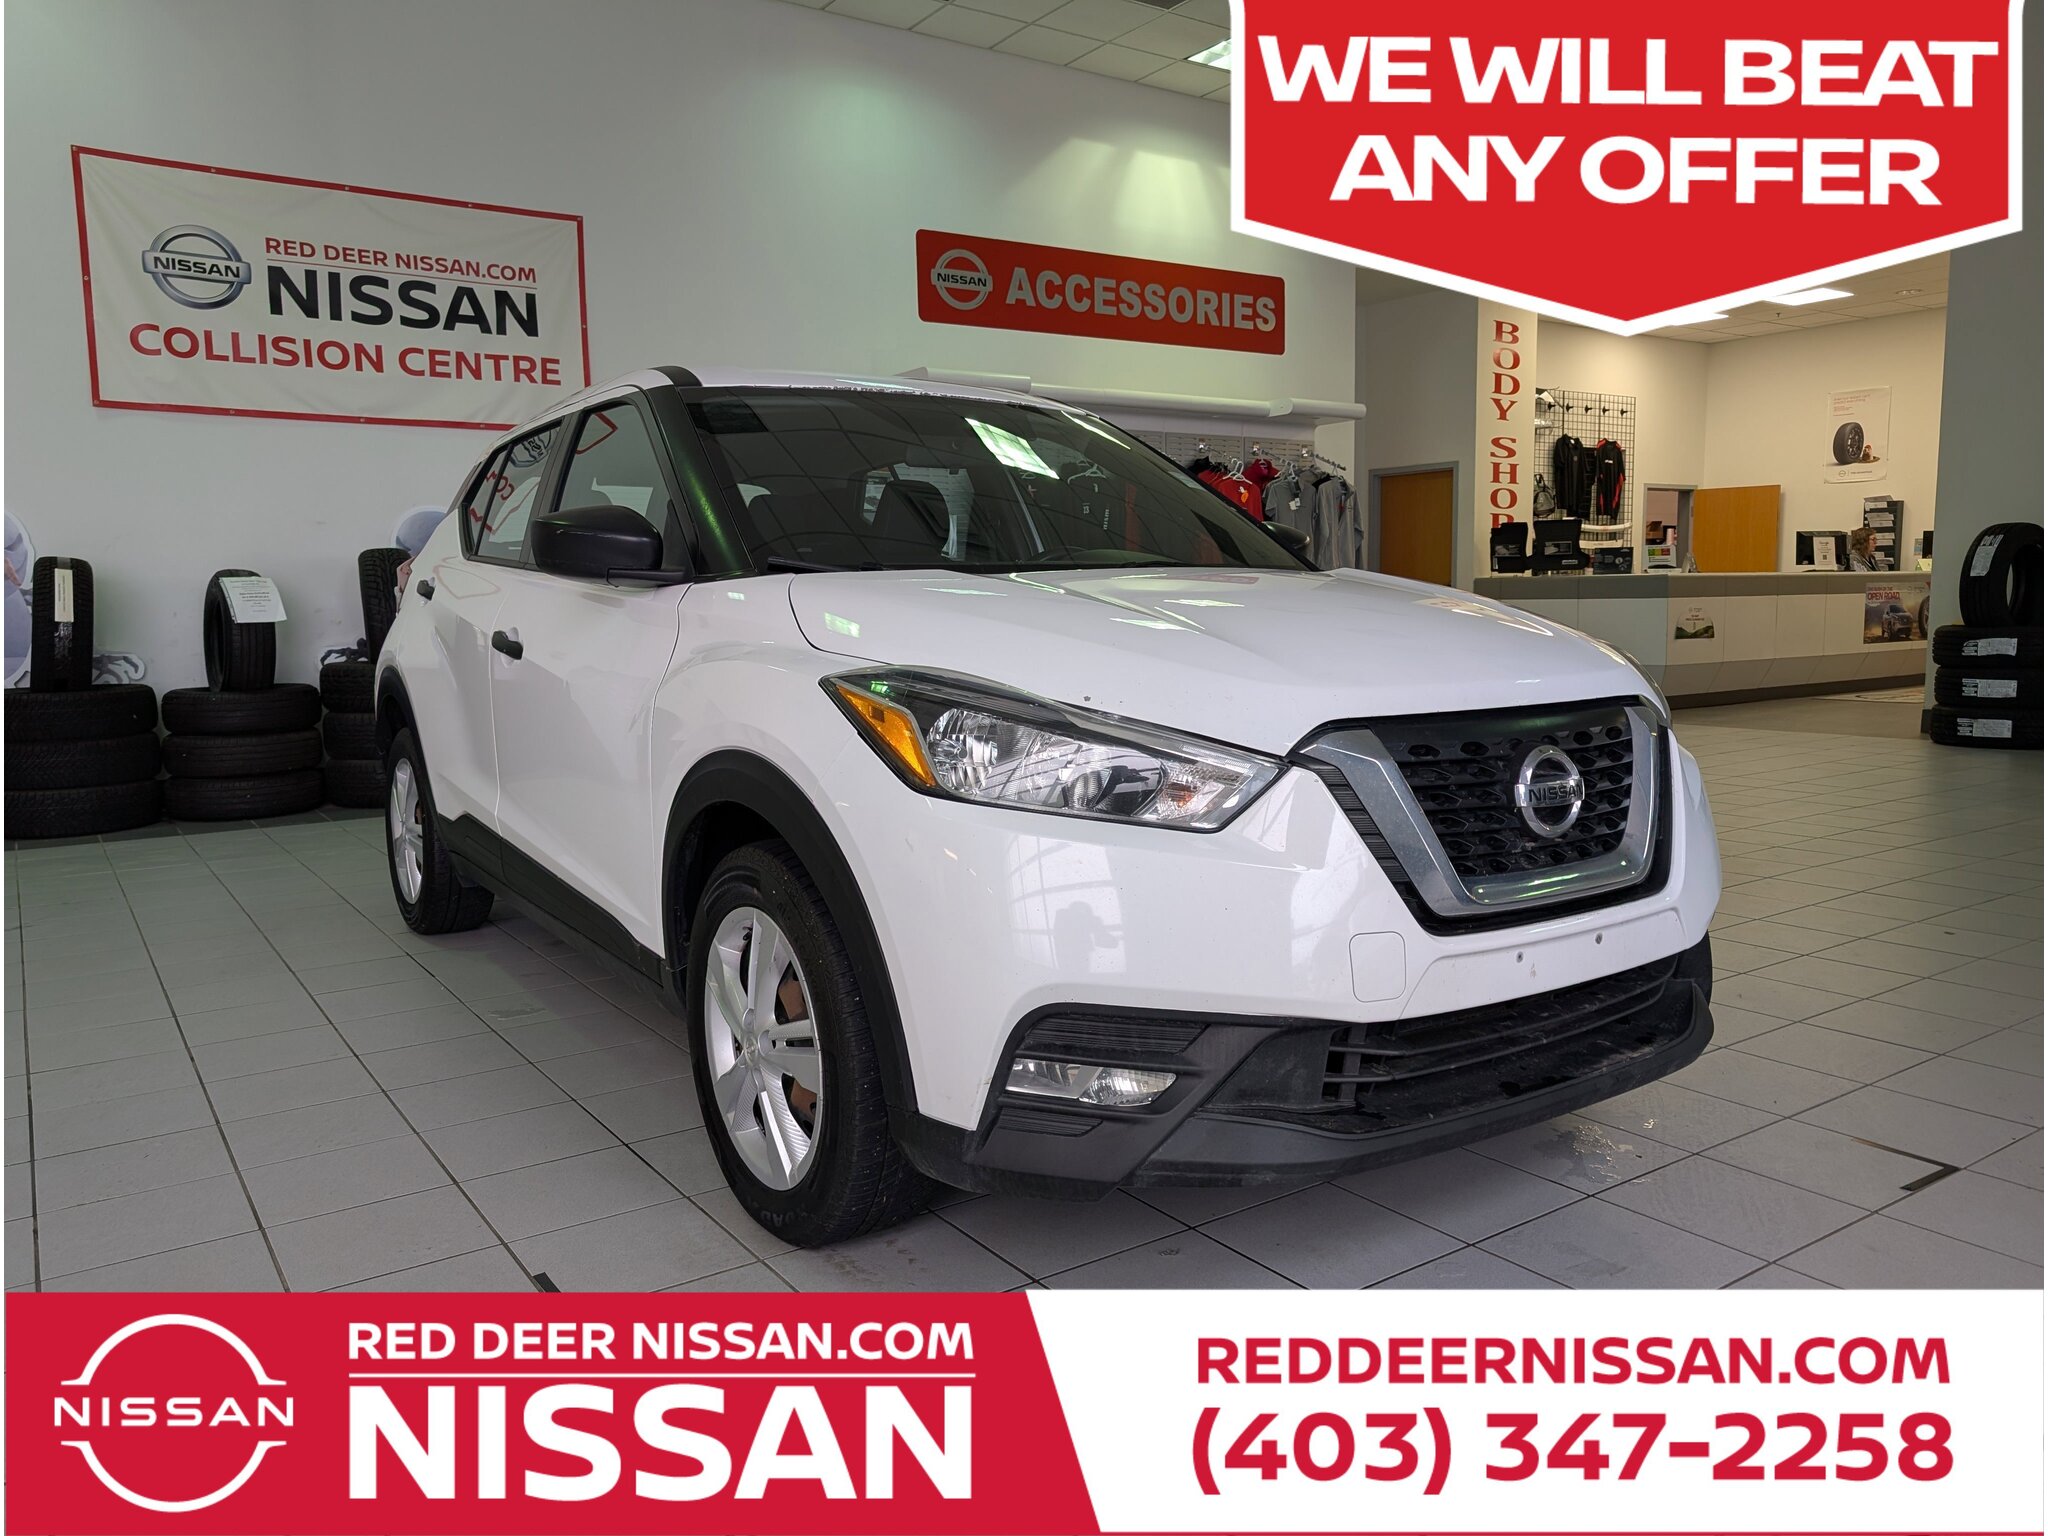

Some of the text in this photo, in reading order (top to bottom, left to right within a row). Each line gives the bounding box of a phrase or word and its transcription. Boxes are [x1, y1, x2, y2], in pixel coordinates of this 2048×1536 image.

[153, 256, 240, 279] NISSAN
[265, 237, 537, 283] RED DEER NISSAN.COM
[936, 272, 988, 288] NISSAN
[266, 265, 540, 338] NISSAN
[1005, 266, 1277, 332] ACCESSORIES
[129, 323, 562, 386] COLLISION CENTRE
[1490, 319, 1520, 421] BODY
[1528, 783, 1583, 803] NISSAN
